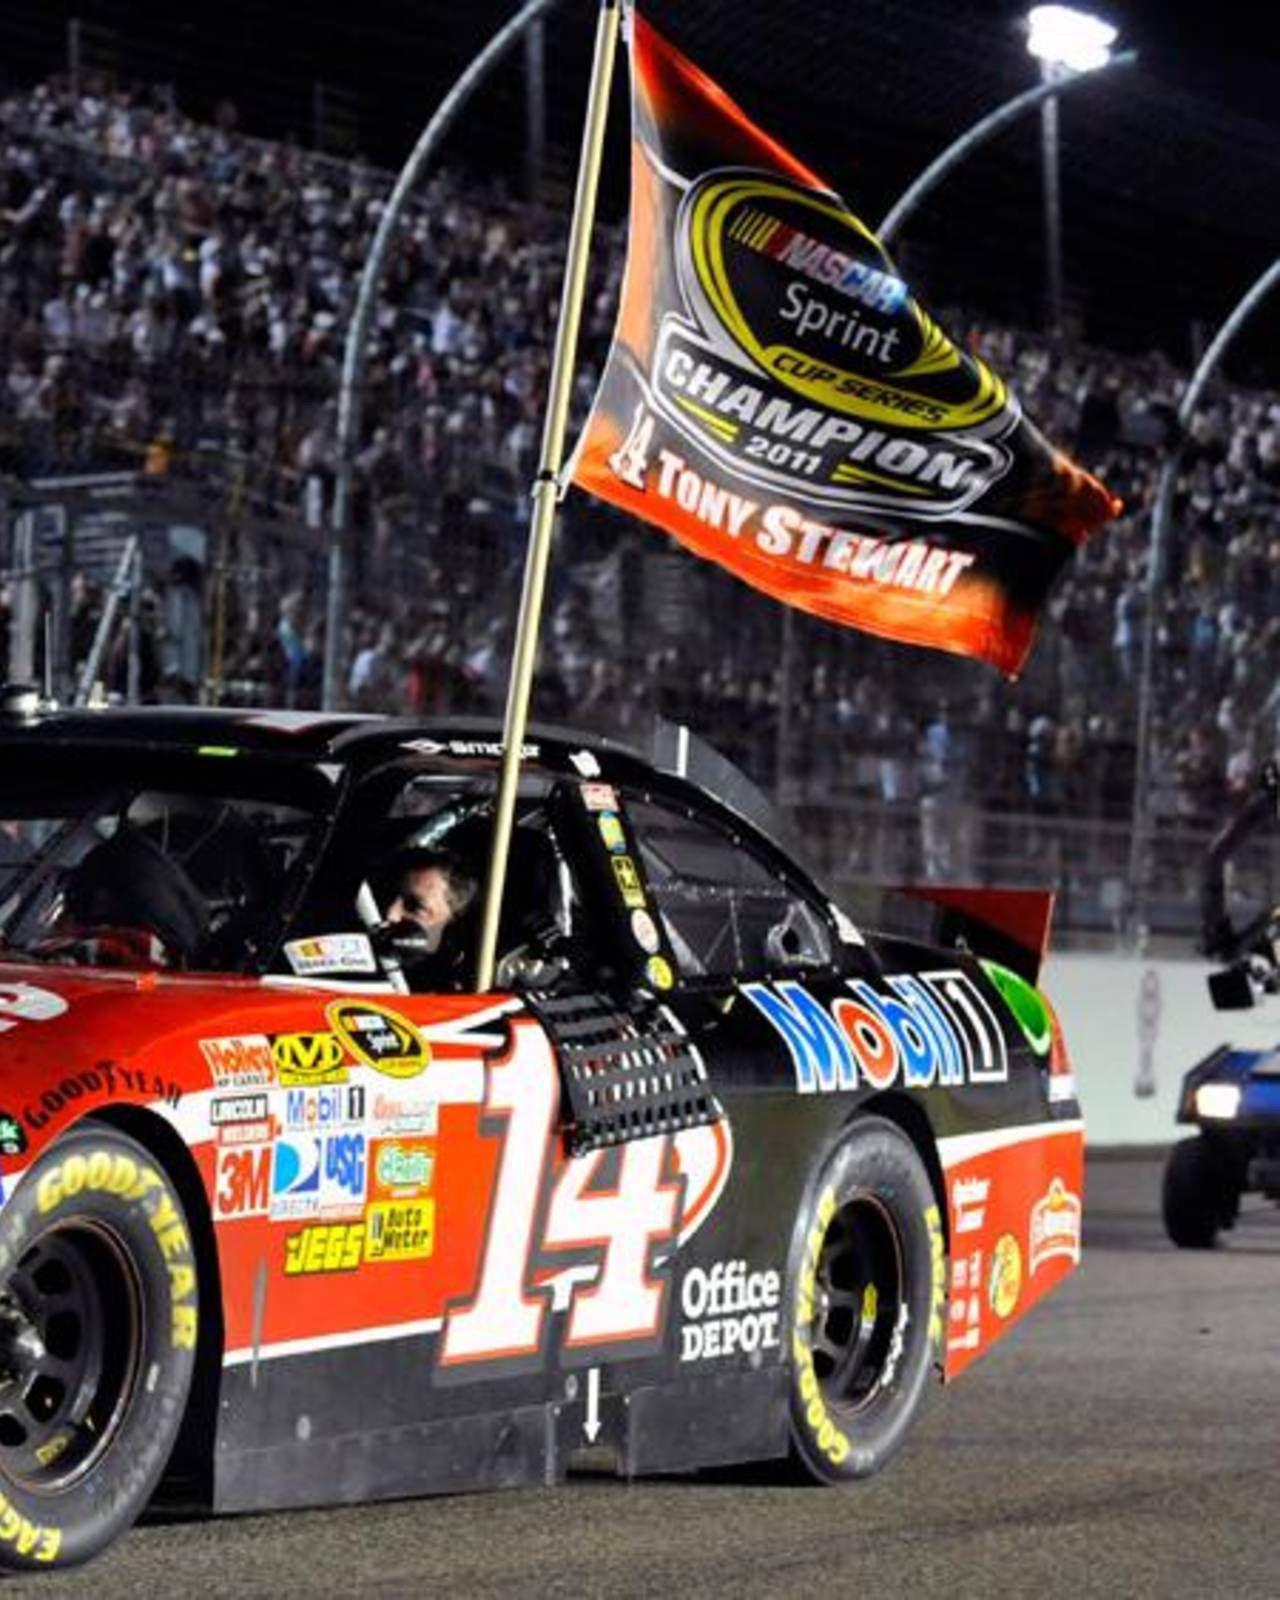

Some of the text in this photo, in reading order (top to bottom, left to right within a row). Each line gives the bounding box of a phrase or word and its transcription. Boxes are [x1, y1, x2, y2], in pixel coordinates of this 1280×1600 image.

[776, 231, 909, 315] NASCAR
[779, 282, 900, 362] Sprint
[665, 350, 973, 488] CHAMPION
[772, 352, 950, 423] CUP SERIES
[744, 435, 822, 475] 2011
[658, 450, 758, 538] TONY
[756, 506, 975, 595] STEWART
[739, 972, 1004, 1093] Mobil 1
[23, 1060, 182, 1129] GOODYEAR
[287, 1088, 342, 1124] Mobil
[218, 1148, 271, 1214] 3M
[439, 1018, 682, 1366] 14
[36, 1152, 198, 1350] GOODYEAR
[285, 1224, 365, 1275] JEGS
[681, 1260, 780, 1318] Office
[680, 1312, 780, 1361] DEPOT
